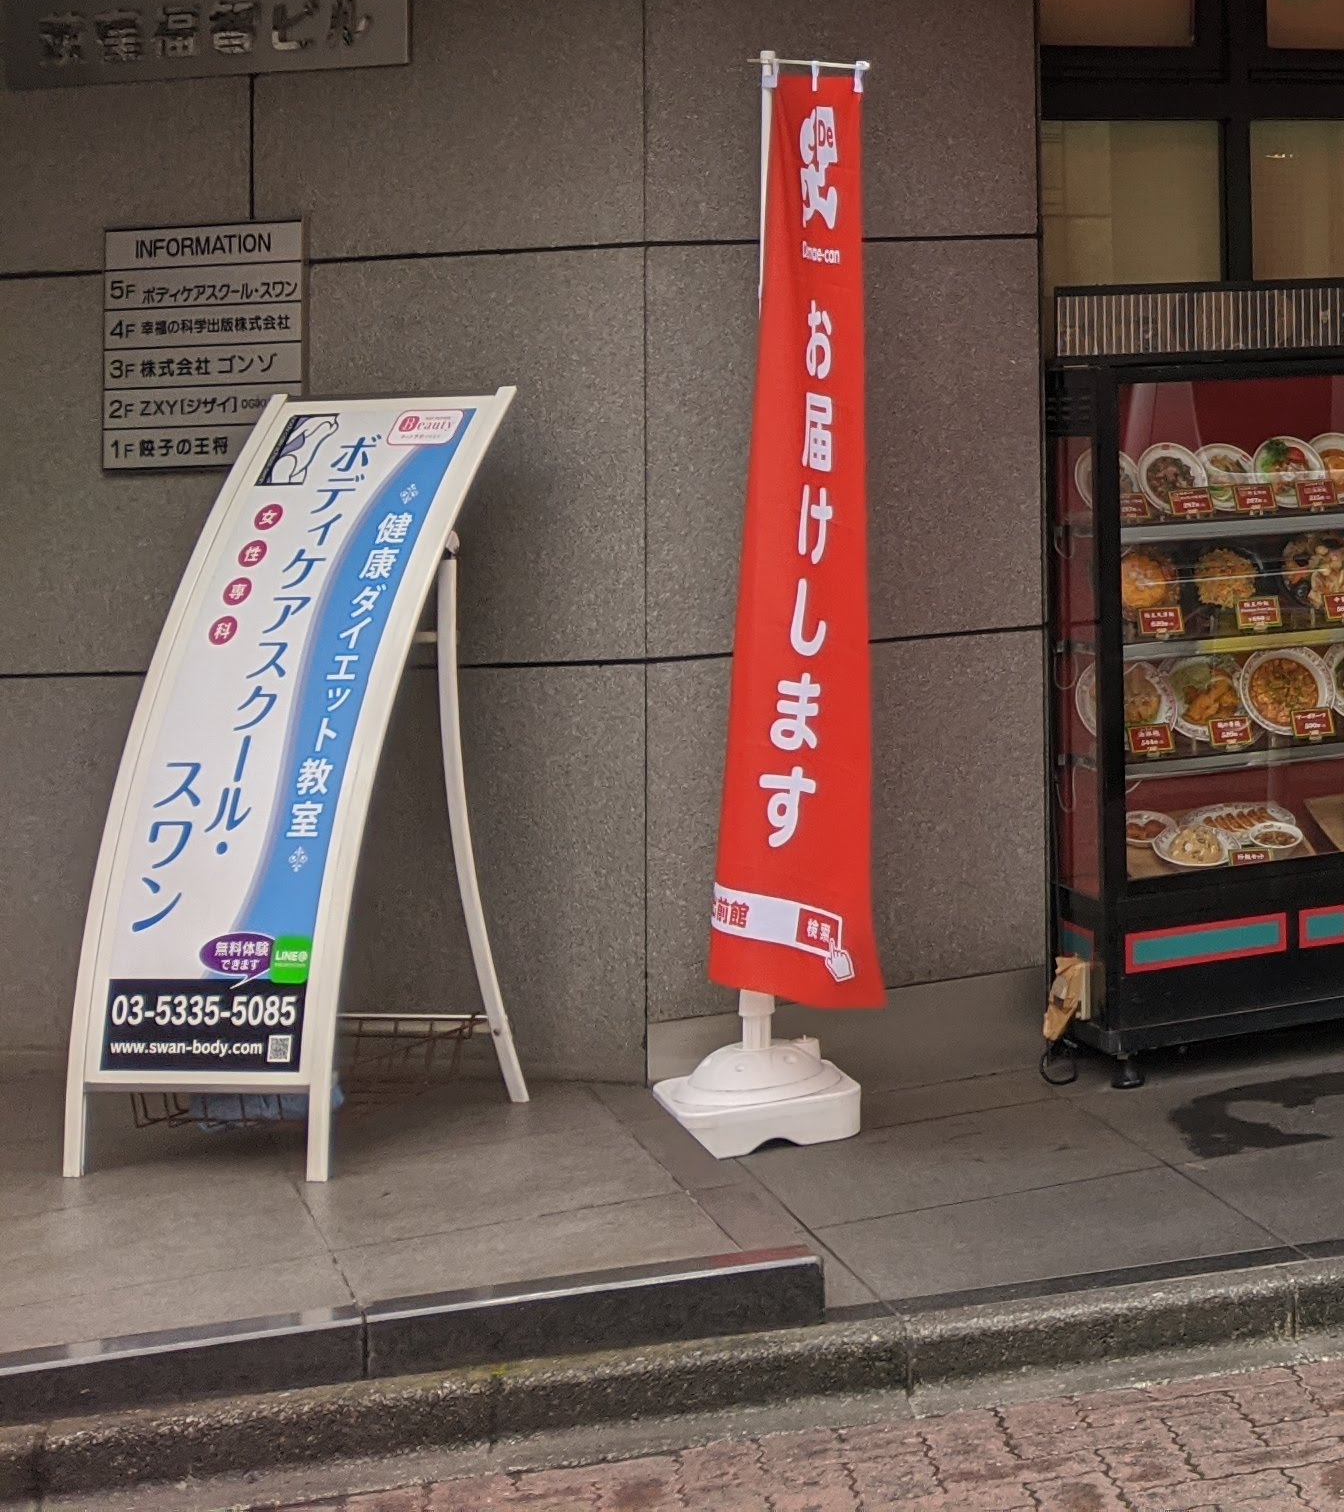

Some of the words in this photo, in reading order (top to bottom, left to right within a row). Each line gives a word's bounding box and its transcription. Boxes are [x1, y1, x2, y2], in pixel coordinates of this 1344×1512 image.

[136, 233, 271, 259] INFORMATION
[110, 280, 136, 300] 5F
[141, 281, 298, 304] ボディケアスクール・スワン
[110, 320, 136, 339] 4F
[141, 314, 290, 336] 幸福の科学出版株式会社
[110, 360, 136, 379] 3F
[140, 356, 211, 378] 株式会社
[217, 352, 278, 374] ゴンゾ
[109, 399, 135, 419] 2F
[399, 415, 455, 433] Beauty
[111, 440, 135, 460] 1F
[139, 436, 228, 457] 餃子の王将
[212, 508, 280, 644] 女性専科
[759, 299, 836, 849] お届けします
[285, 511, 413, 840] 健康ダイエット教室
[131, 759, 202, 934] スワン
[214, 941, 270, 957] 無料体験
[275, 950, 308, 962] LINE@
[220, 959, 260, 971] できます
[111, 994, 299, 1027] 03-5335-5085
[110, 1039, 263, 1058] www.swan-body.com
